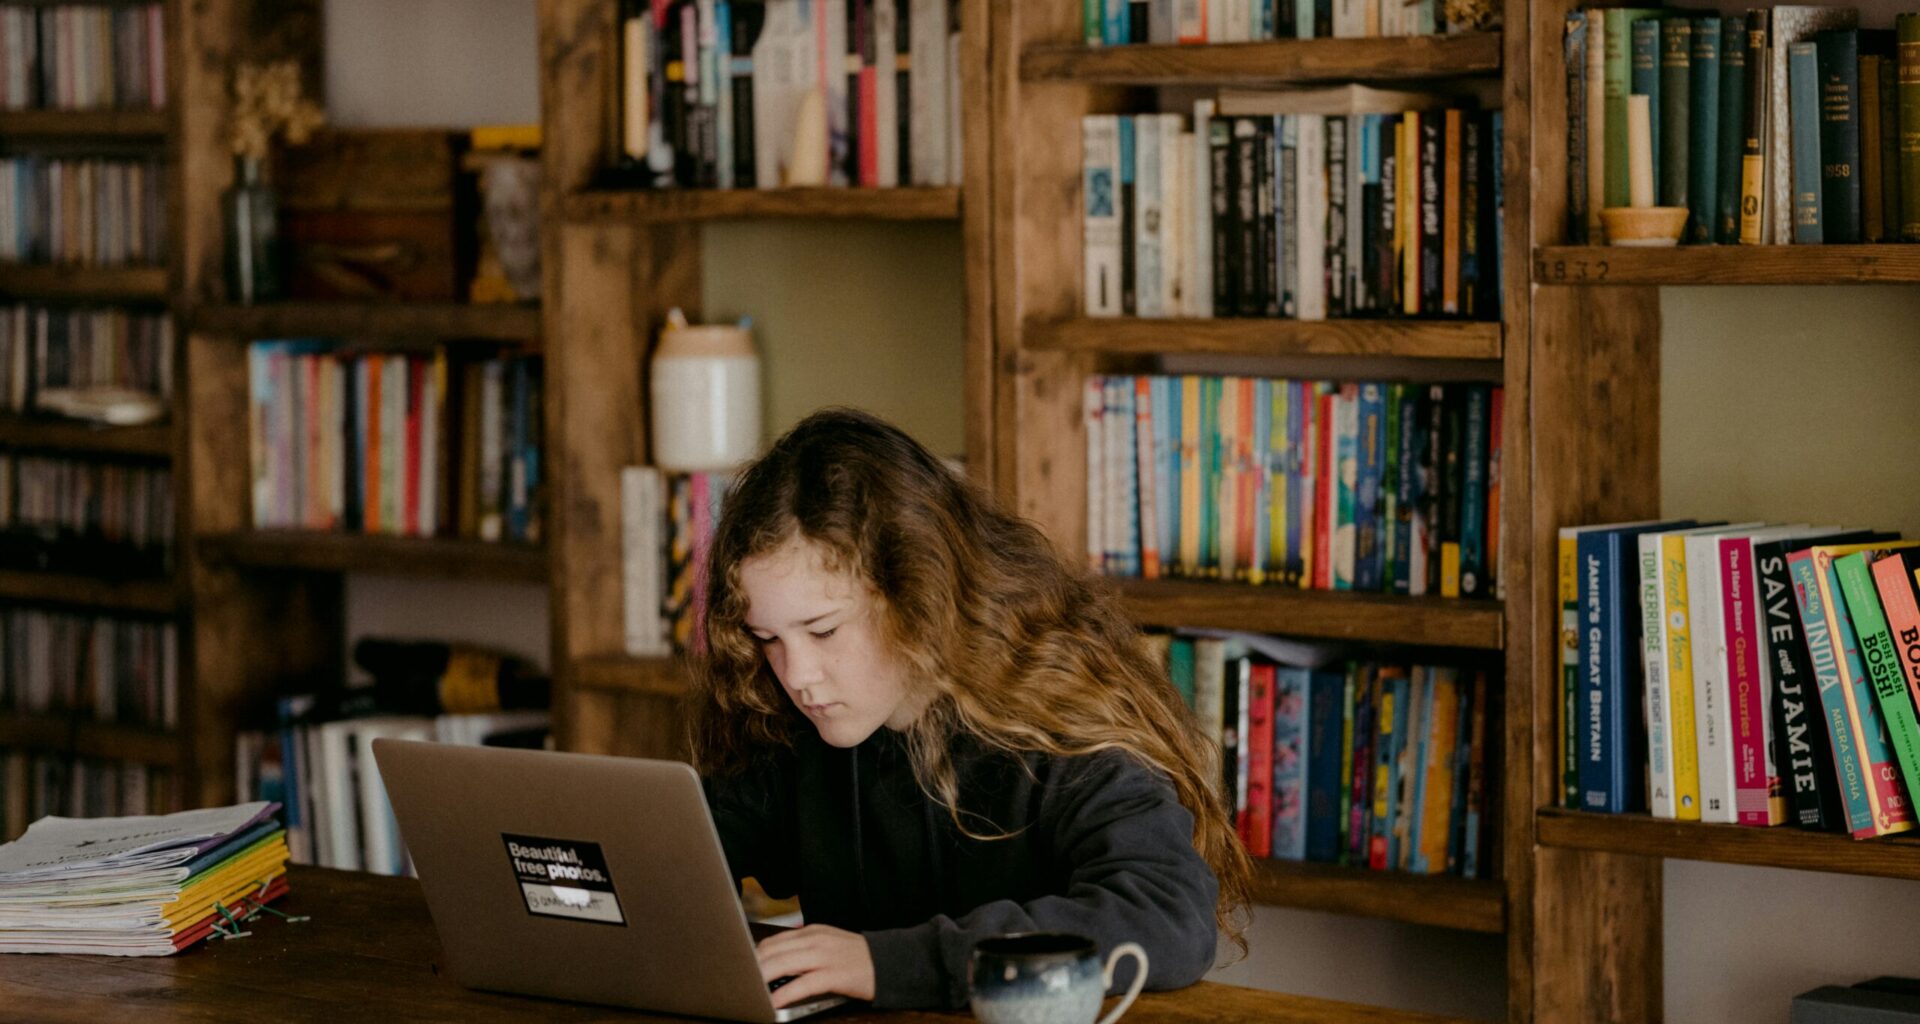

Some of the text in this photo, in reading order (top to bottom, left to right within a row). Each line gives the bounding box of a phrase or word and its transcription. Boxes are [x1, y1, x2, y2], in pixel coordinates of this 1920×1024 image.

[1643, 551, 1661, 653] TOM KERRIDGE
[1799, 566, 1818, 600] MADE
[1588, 554, 1602, 761] JAMIE'S GREAT BRITAIN
[1650, 661, 1660, 684] LOSE
[1730, 548, 1750, 737] The Hairy Bikers' Great Curries
[1761, 556, 1794, 643] SAVE
[1780, 680, 1816, 793] JAMIE
[1806, 620, 1839, 693] INDIA
[1862, 633, 1895, 700] BOSH!
[1878, 630, 1904, 694] BISH BASH
[1651, 687, 1661, 723] WEIGHT
[1653, 725, 1664, 745] FOR
[1707, 713, 1715, 747] JONES
[1831, 708, 1860, 801] MEERA SODHA
[508, 842, 583, 865] Beautiful,
[514, 858, 607, 883] free photos.
